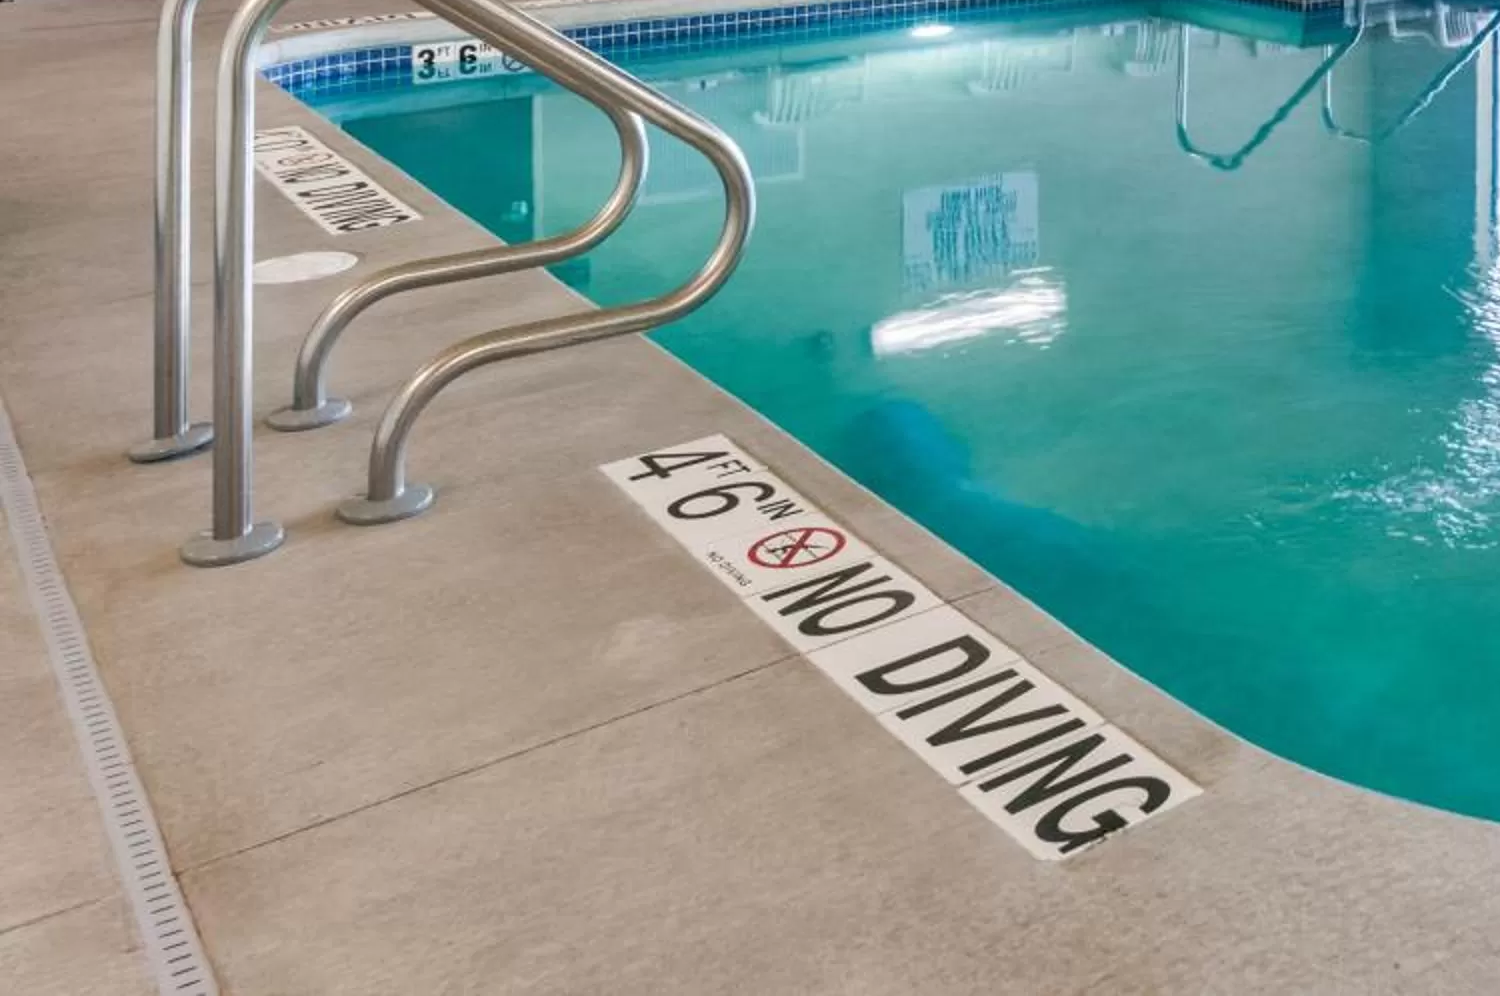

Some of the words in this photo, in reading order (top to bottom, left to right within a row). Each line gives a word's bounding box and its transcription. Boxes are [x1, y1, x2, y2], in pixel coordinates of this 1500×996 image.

[296, 180, 411, 232] DIVING
[761, 561, 916, 636] NO
[854, 634, 1171, 854] DIVING
